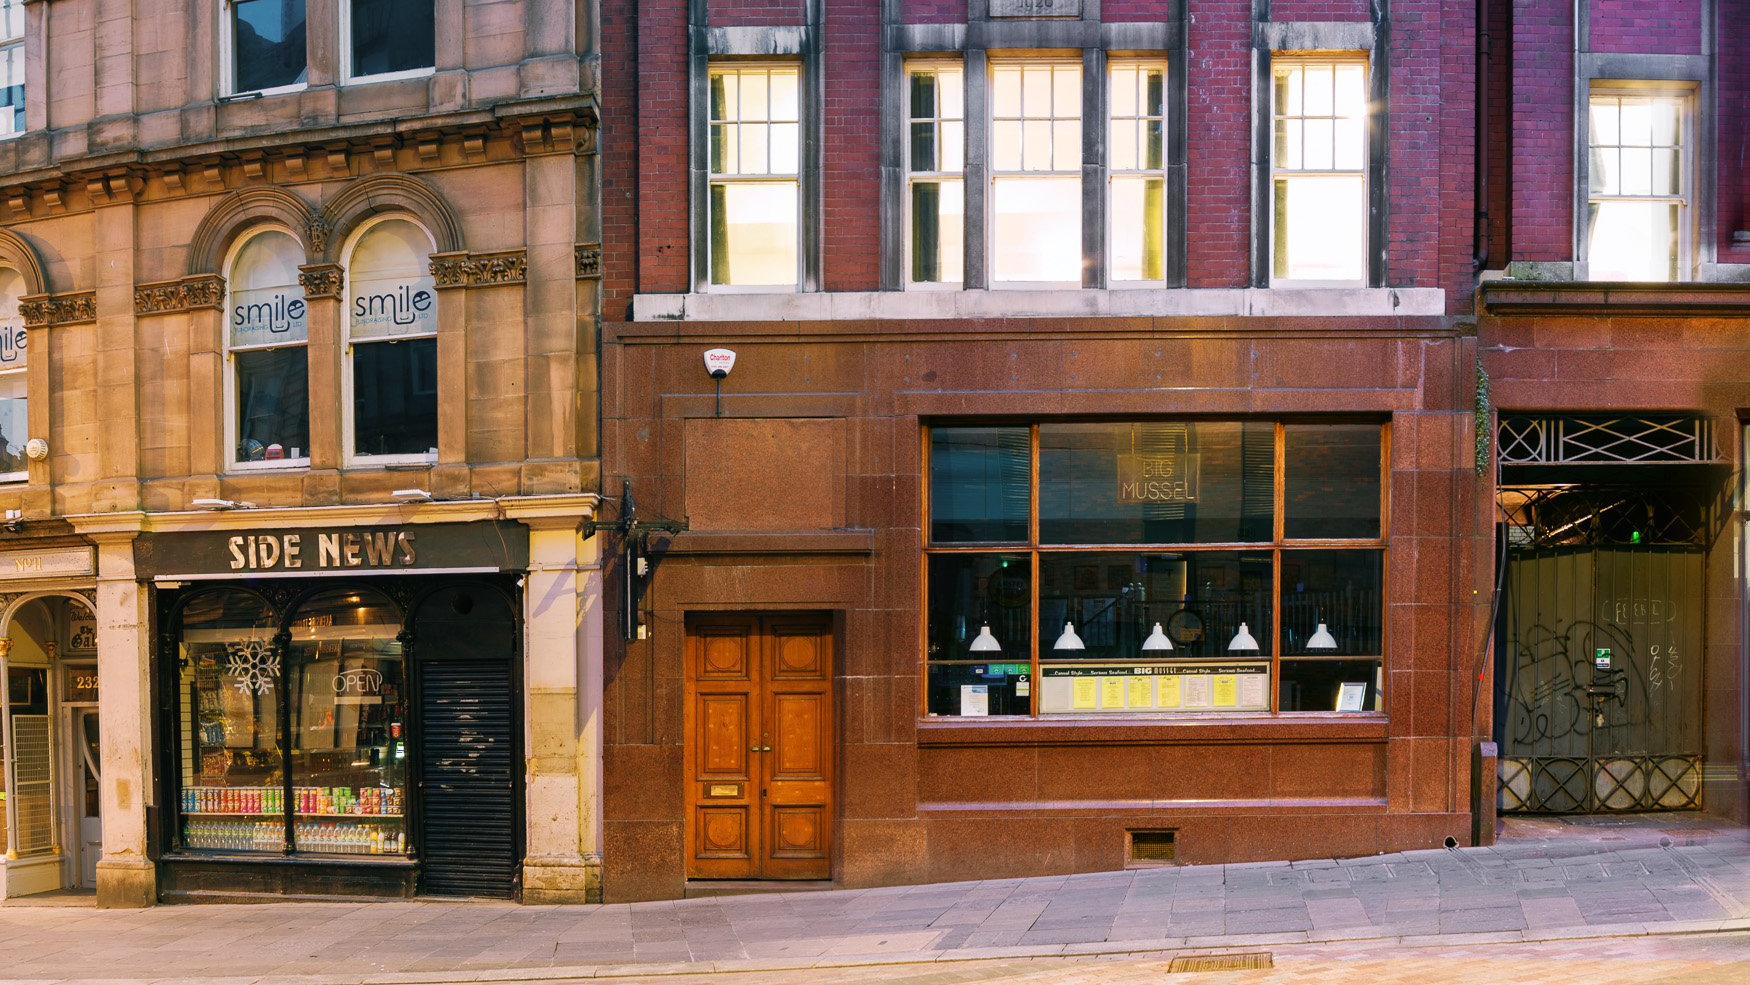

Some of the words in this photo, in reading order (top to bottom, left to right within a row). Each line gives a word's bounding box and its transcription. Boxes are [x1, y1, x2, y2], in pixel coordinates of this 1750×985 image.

[234, 294, 305, 333] smile
[355, 285, 432, 325] smile
[1143, 460, 1173, 477] BIG
[1122, 481, 1195, 500] MUSSEL
[228, 534, 302, 569] SIDE
[318, 531, 416, 568] NEWS
[332, 670, 382, 692] OPEN
[1134, 667, 1153, 675] BIG
